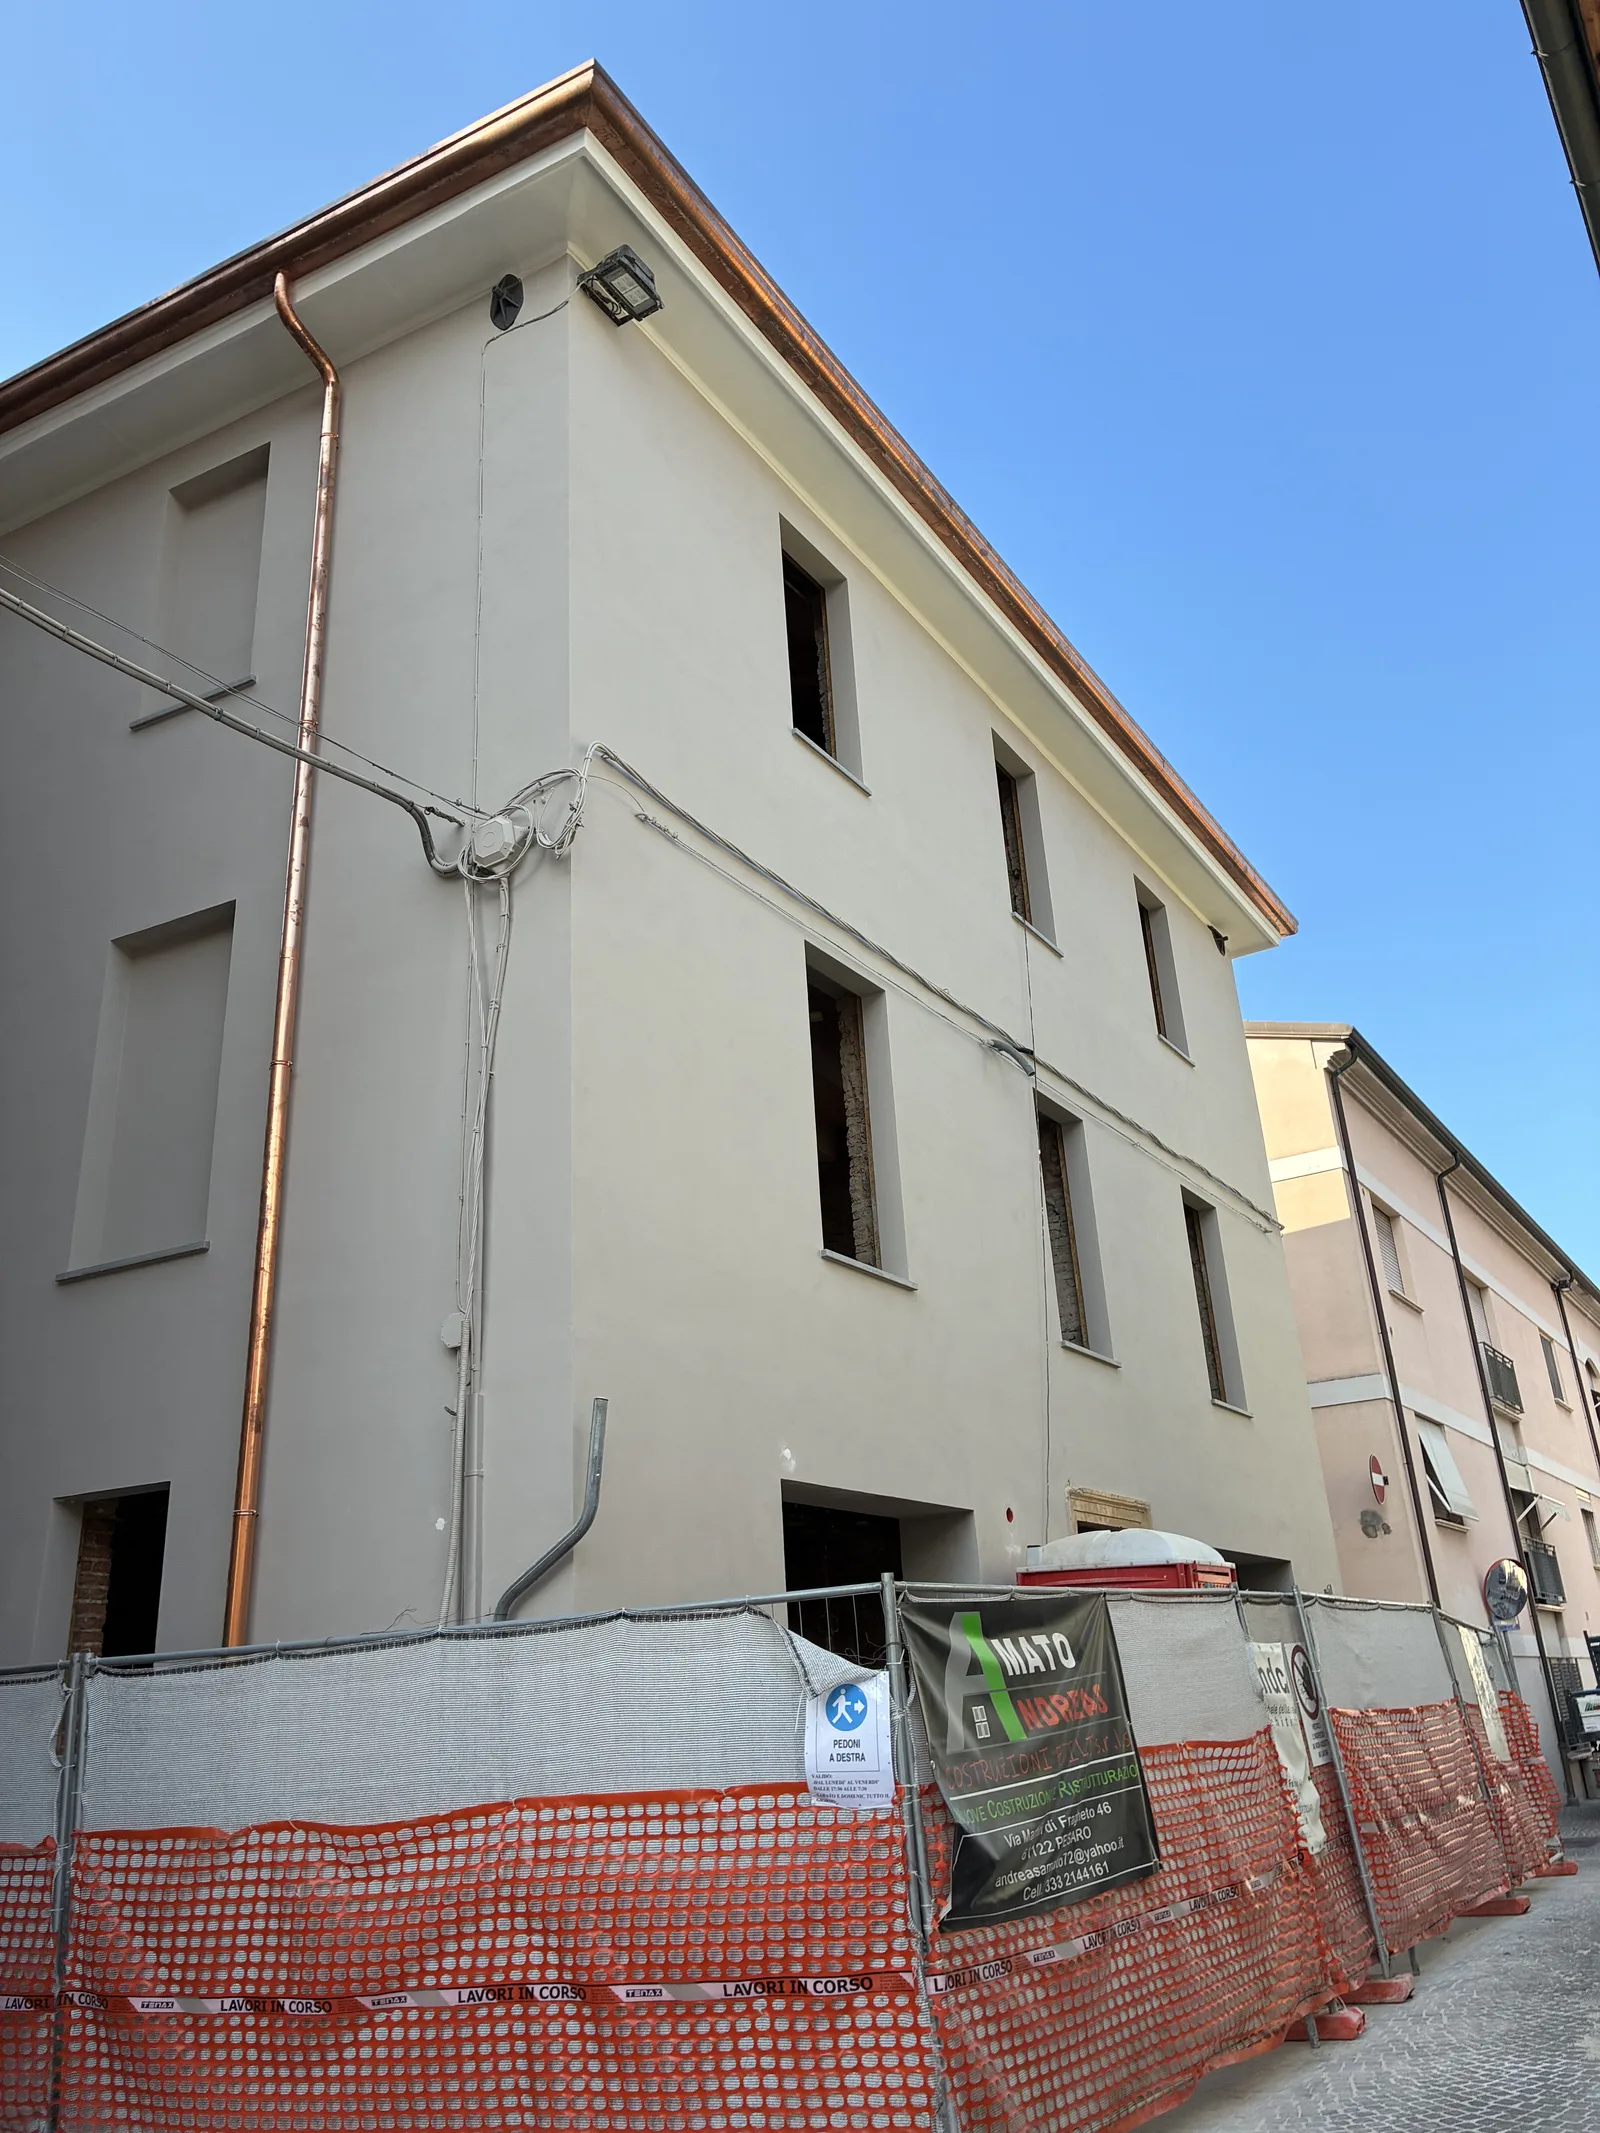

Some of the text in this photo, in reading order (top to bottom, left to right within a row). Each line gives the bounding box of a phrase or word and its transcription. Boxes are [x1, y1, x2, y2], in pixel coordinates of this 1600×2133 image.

[833, 1739, 861, 1749] PEDONI
[829, 1752, 866, 1762] A DESTRA
[1004, 1833, 1022, 1848] Via
[1044, 1820, 1057, 1833] di
[1097, 1801, 1112, 1815] 46
[1044, 1875, 1063, 1893] 333
[1064, 1860, 1110, 1887] 2144161
[968, 1970, 980, 1985] IN
[982, 1960, 1013, 1981] CORSO
[458, 1987, 514, 2003] LAVORI
[518, 1987, 534, 2000] IN
[539, 1986, 587, 2000] CORSO
[723, 1980, 785, 1997] LAVORI
[790, 1980, 808, 1994] IN
[813, 1976, 873, 1995] CORSO
[5, 1996, 49, 2010] LAVORI
[57, 1993, 75, 2006] IN
[78, 1993, 109, 2009] CORSO
[220, 1999, 266, 2012] LAVORI
[271, 2000, 285, 2012] IN
[288, 2000, 332, 2013] CORSO
